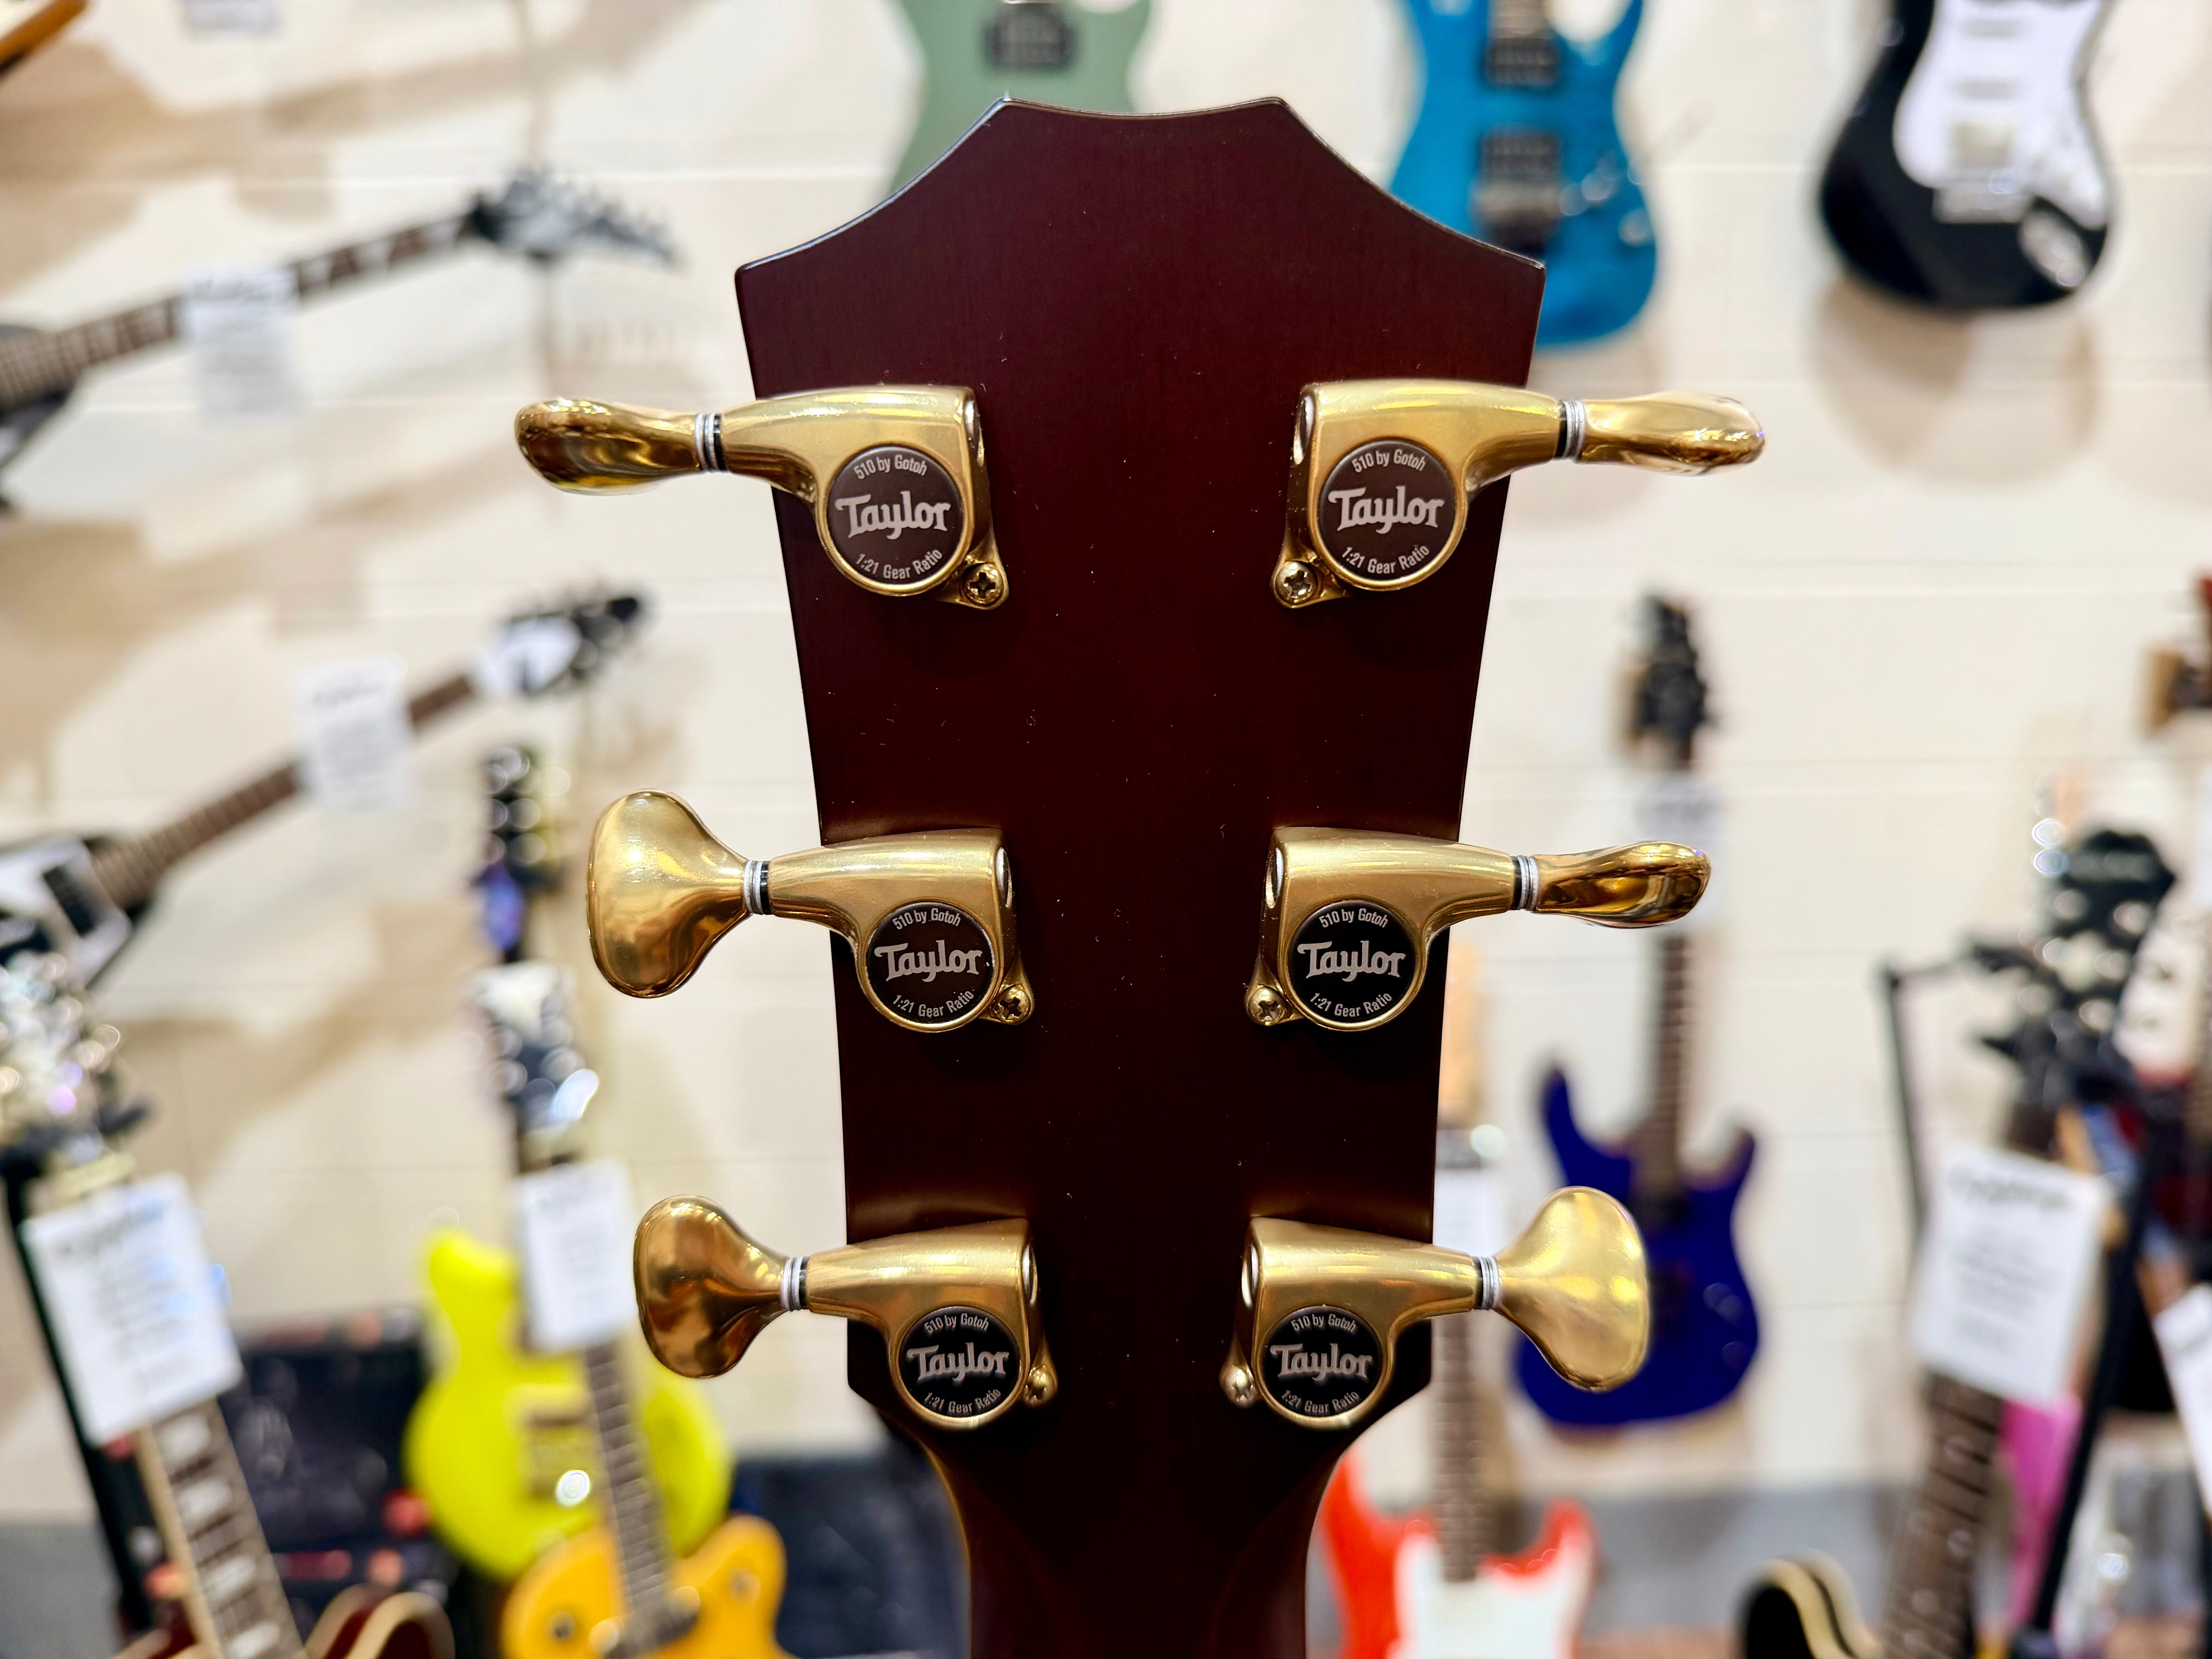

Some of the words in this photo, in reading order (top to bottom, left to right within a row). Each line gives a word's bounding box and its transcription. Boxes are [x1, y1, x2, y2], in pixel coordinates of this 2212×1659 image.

[854, 460, 876, 479] 510
[876, 457, 890, 473] by
[894, 454, 927, 476] Gotoh
[1352, 453, 1374, 472] 510
[1376, 450, 1390, 467] by
[1394, 448, 1426, 471] Gotoh
[835, 491, 951, 539] Taylor
[1328, 486, 1444, 534] Taylor
[856, 553, 879, 574] 1:21
[883, 564, 910, 579] Gear
[912, 549, 943, 575] Ratio
[1342, 547, 1365, 568] 1:21
[1367, 558, 1395, 574] Gear
[1398, 545, 1430, 570] Ratio
[892, 912, 913, 929] 510
[914, 910, 927, 924] by
[931, 908, 961, 926] Gotoh
[1319, 911, 1340, 928] 510
[1341, 909, 1355, 923] by
[1358, 908, 1388, 928] Gotoh
[874, 940, 982, 982] Taylor
[1297, 940, 1406, 982] Taylor
[893, 995, 914, 1013] 1:21
[918, 1004, 944, 1018] Gear
[946, 991, 974, 1013] Ratio
[1310, 993, 1332, 1011] 1:21
[1334, 1003, 1360, 1017] Gear
[1363, 993, 1392, 1014] Ratio
[924, 1317, 943, 1333] 510
[944, 1315, 957, 1328] by
[961, 1313, 989, 1330] Gotoh
[1291, 1316, 1310, 1331] 510
[1312, 1314, 1324, 1327] by
[1328, 1314, 1357, 1333] Gotoh
[907, 1342, 1009, 1382] Taylor
[1270, 1343, 1373, 1382] Taylor
[925, 1393, 945, 1409] 1:21
[948, 1401, 972, 1413] Gear
[975, 1389, 1001, 1409] Ratio
[1281, 1390, 1302, 1407] 1:21
[1304, 1400, 1329, 1413] Gear
[1332, 1391, 1361, 1411] Ratio
